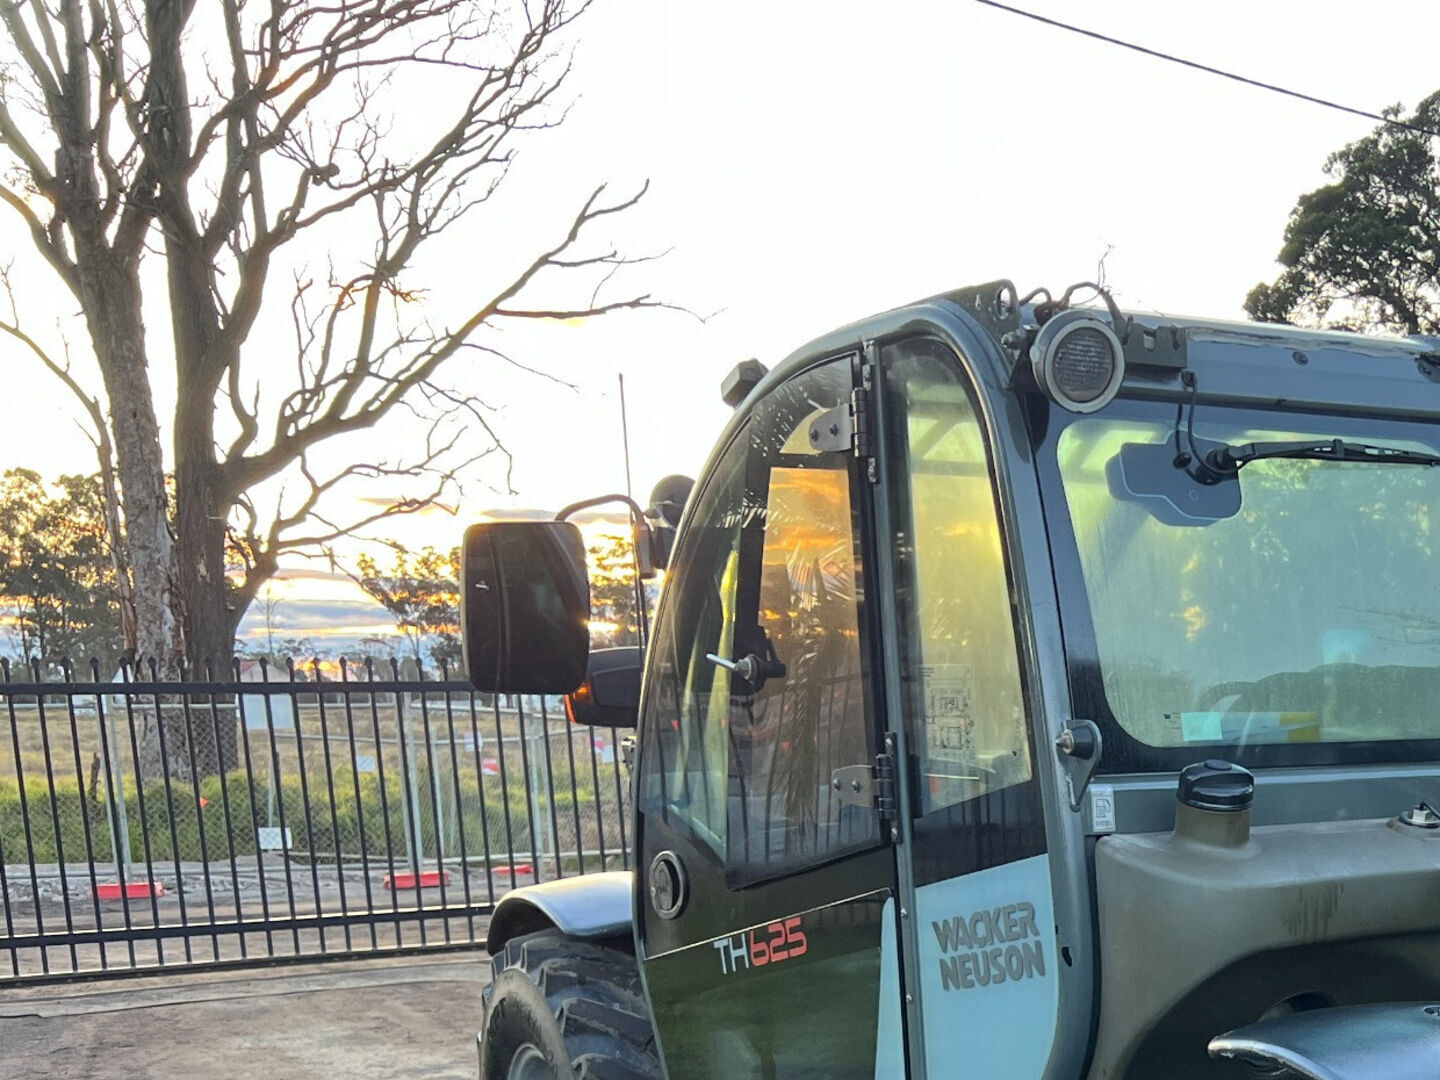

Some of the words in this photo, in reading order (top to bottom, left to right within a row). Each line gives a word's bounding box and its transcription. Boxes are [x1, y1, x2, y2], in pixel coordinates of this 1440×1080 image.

[713, 916, 808, 975] TH625
[931, 901, 1040, 954] WACKER
[939, 940, 1046, 992] NEUSON
